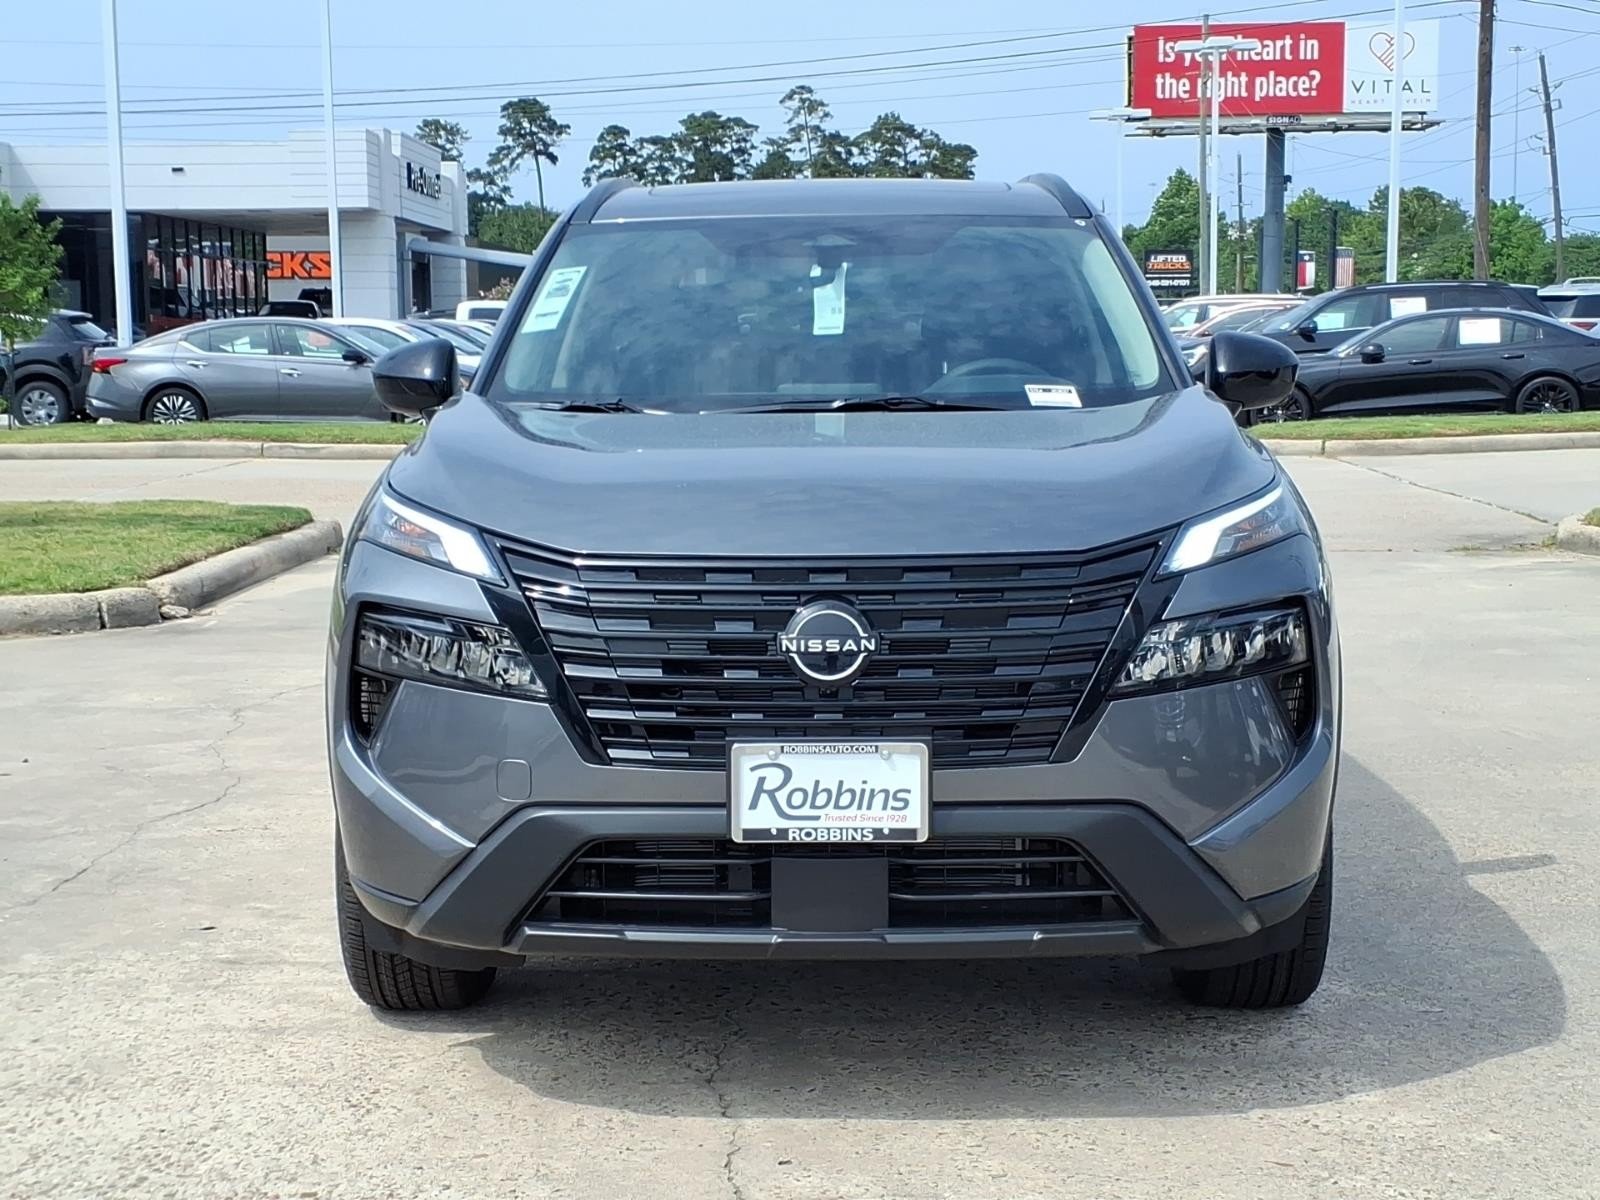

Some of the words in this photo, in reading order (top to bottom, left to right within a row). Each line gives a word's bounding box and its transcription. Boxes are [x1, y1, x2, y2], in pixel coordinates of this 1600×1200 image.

[1158, 36, 1176, 63] Is
[1299, 33, 1319, 60] in
[1155, 72, 1190, 99] the
[1254, 69, 1321, 102] place?
[1351, 79, 1431, 94] VITAL
[1150, 255, 1187, 263] LIFTED
[1146, 262, 1191, 271] TRUCKS
[781, 638, 876, 652] NISSAN
[783, 745, 876, 754] ROBBINSAUTO.COM
[748, 762, 912, 821] Robbins
[824, 813, 857, 822] Trusted
[859, 814, 884, 823] Since
[886, 814, 908, 823] 1928
[788, 828, 874, 841] ROBBINS
